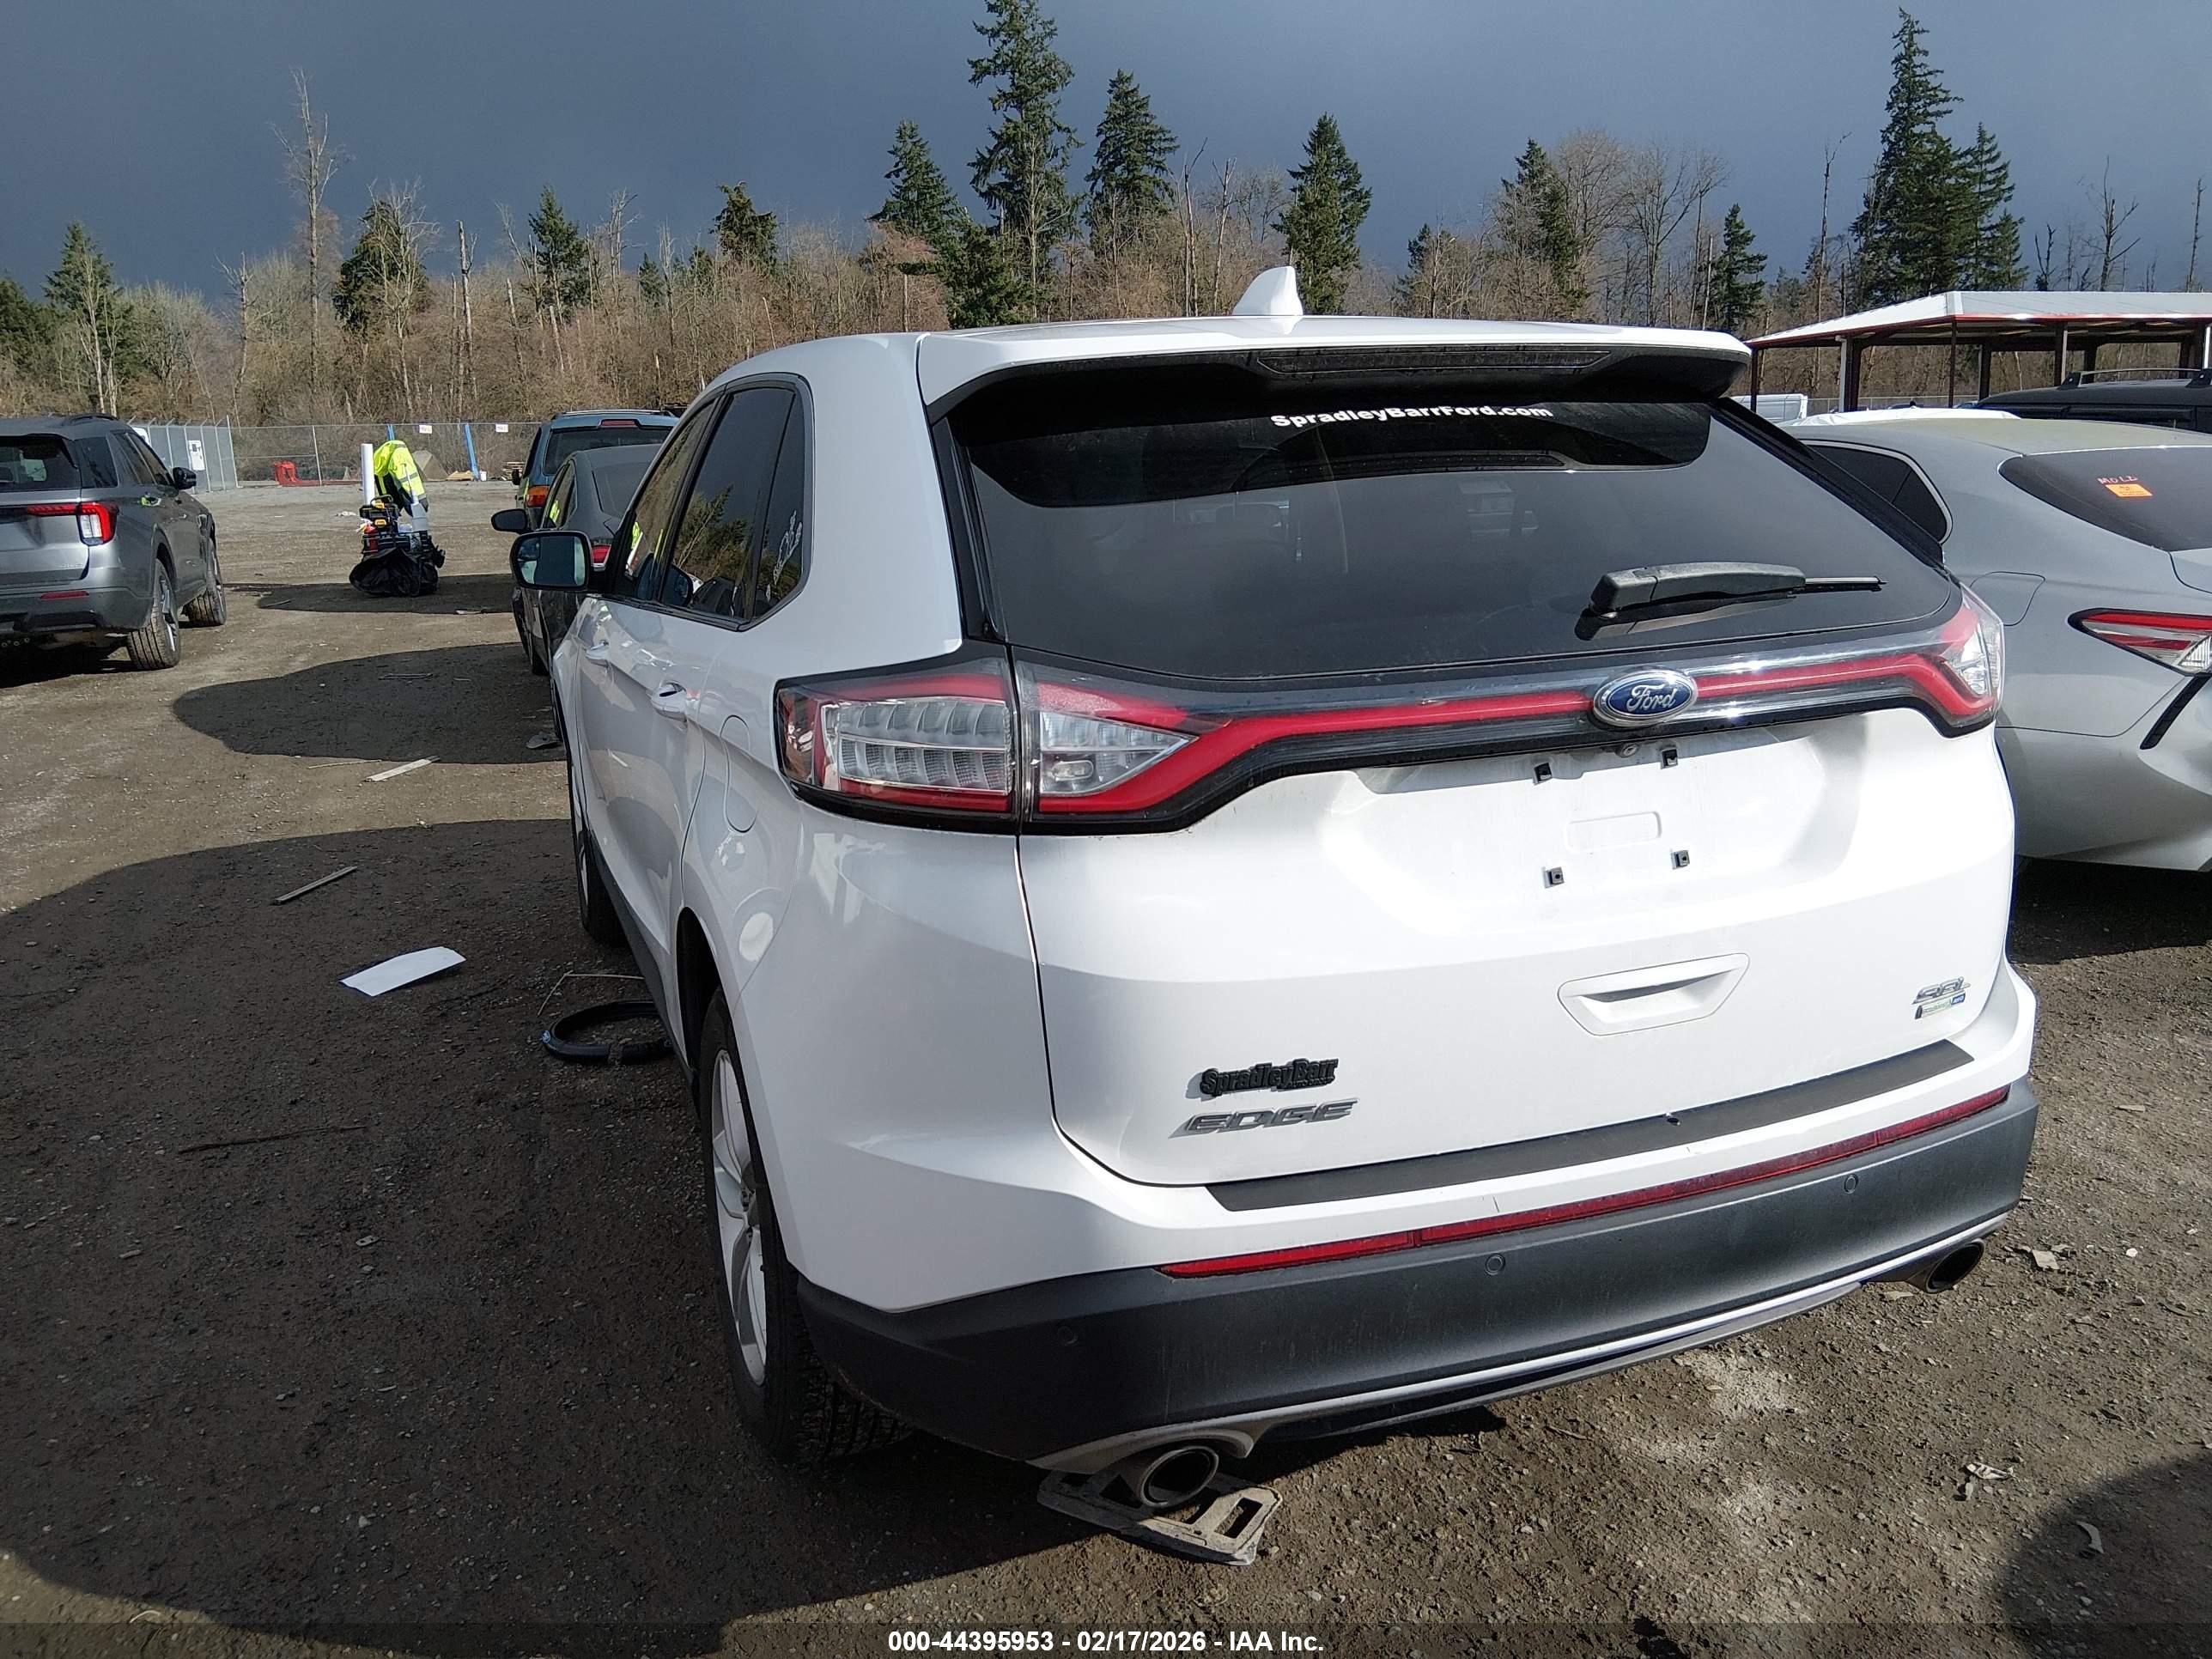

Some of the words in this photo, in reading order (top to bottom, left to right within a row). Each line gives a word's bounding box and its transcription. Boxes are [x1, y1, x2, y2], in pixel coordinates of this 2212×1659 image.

[1270, 405, 1553, 428] SpradleyBarrFord.com
[1626, 684, 1677, 713] Ford
[1182, 1097, 1359, 1133] EDGE
